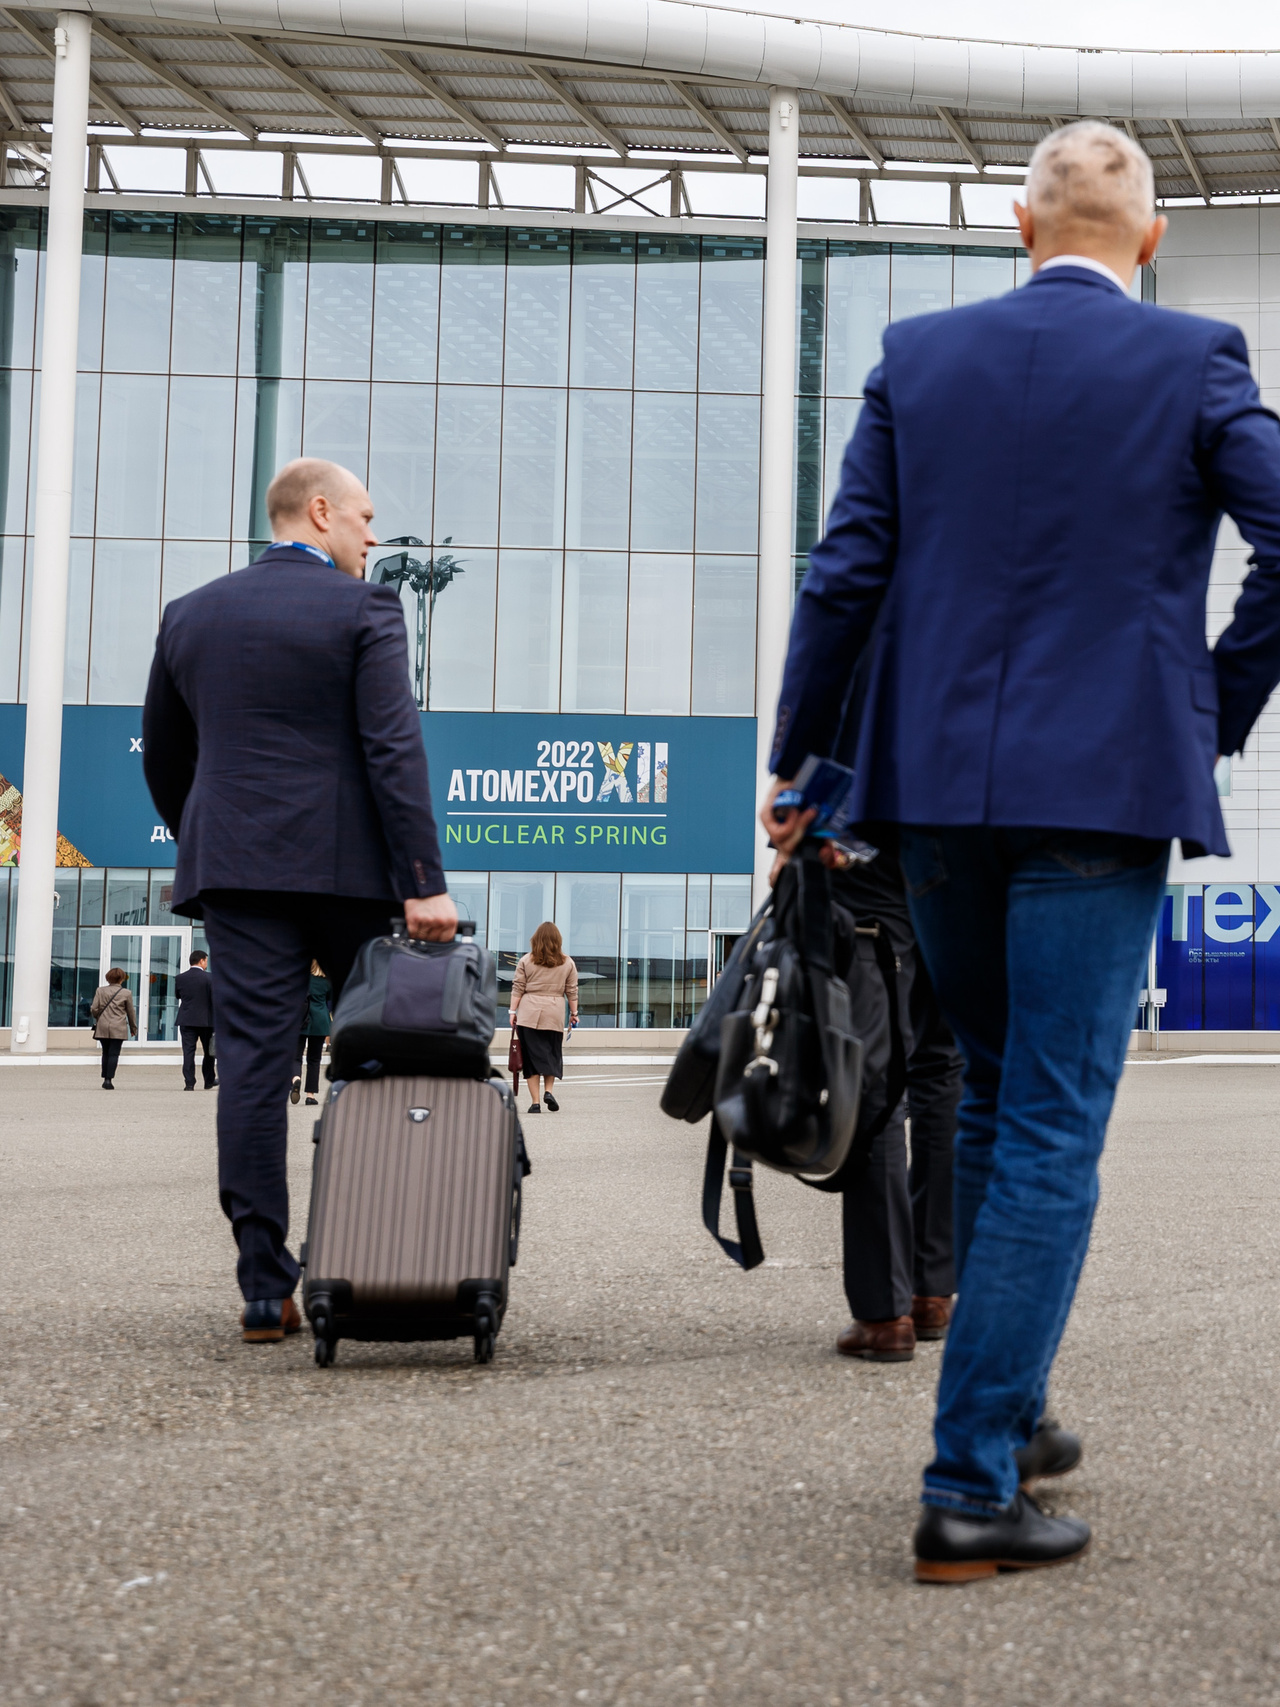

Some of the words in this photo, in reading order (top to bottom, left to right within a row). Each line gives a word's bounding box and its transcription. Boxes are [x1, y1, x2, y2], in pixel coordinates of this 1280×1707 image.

[536, 740, 594, 768] 2022
[447, 769, 594, 803] ATOMEXPO
[597, 741, 669, 803] XII
[446, 824, 565, 844] NUCLEAR
[574, 825, 667, 845] SPRING
